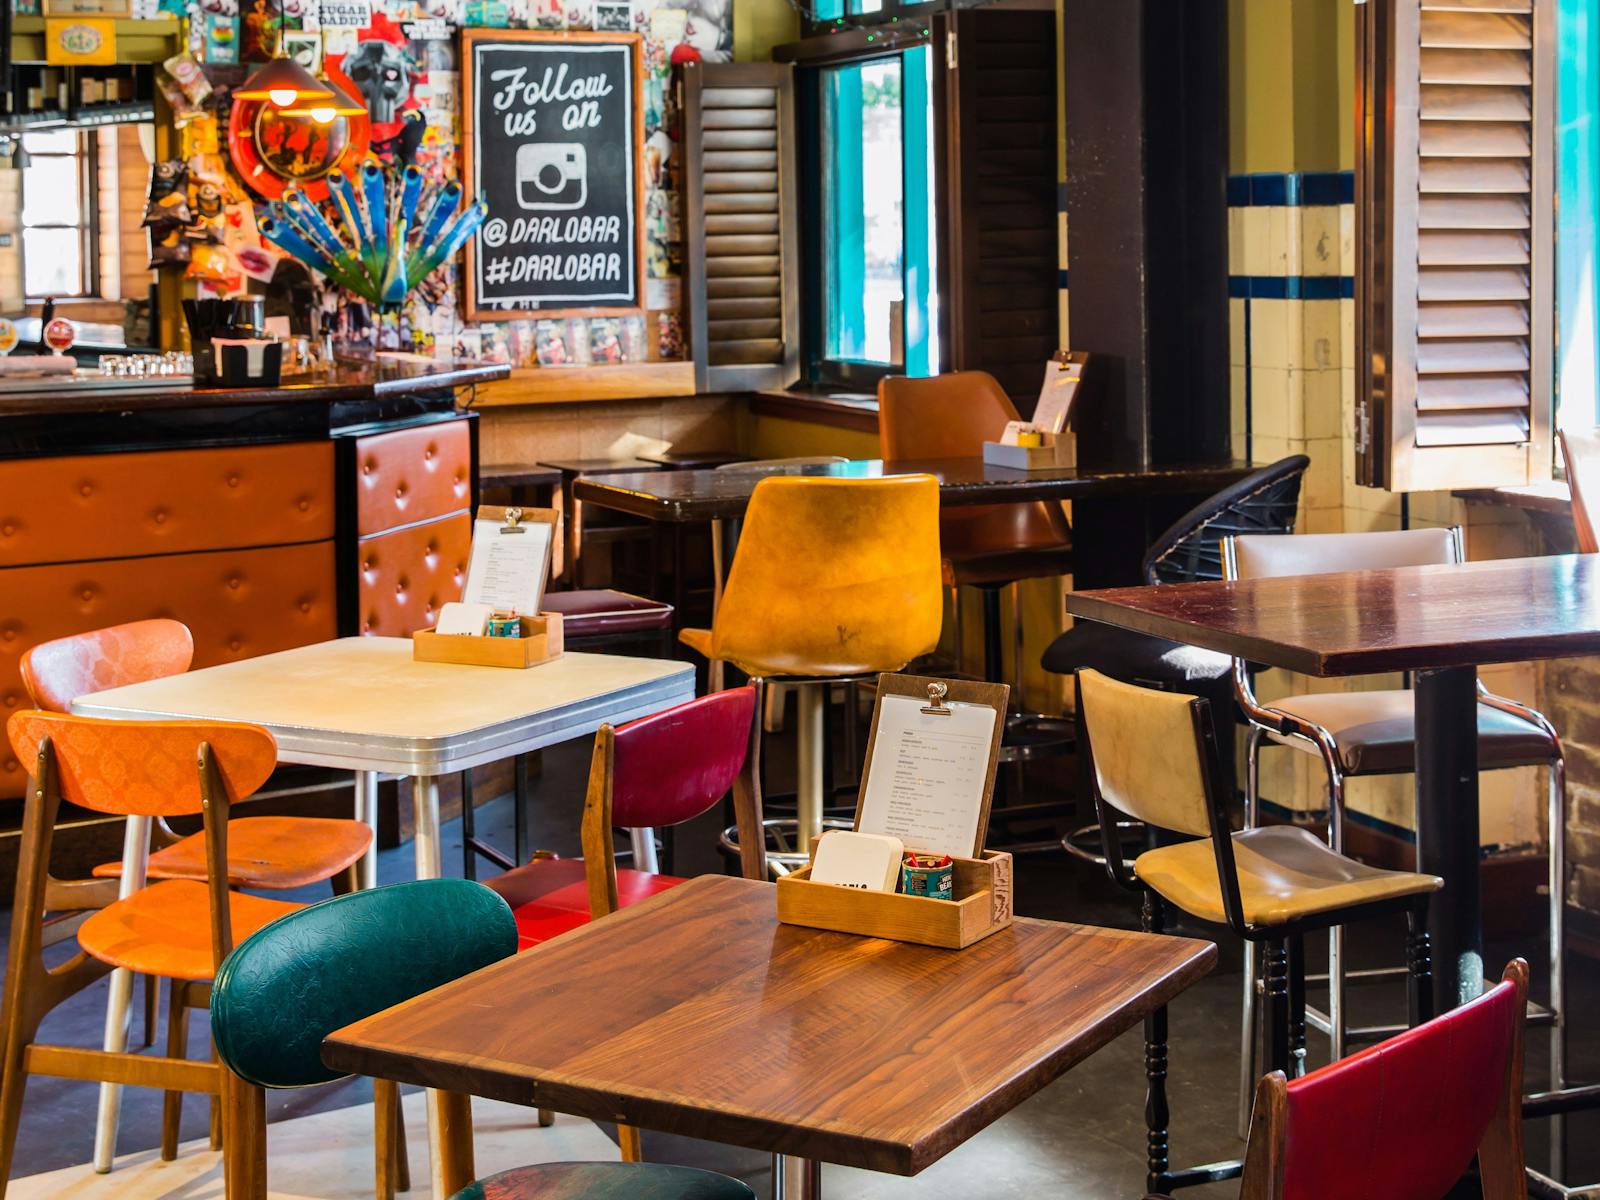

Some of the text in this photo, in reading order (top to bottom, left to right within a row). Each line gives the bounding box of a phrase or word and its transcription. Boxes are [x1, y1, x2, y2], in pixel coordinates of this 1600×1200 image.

[319, 5, 367, 15] SUGAR
[319, 16, 367, 26] DADDY
[490, 62, 613, 110] Follow
[504, 100, 602, 137] us on
[483, 215, 620, 248] @DARLOBAR
[484, 252, 621, 285] #DARLOBAR
